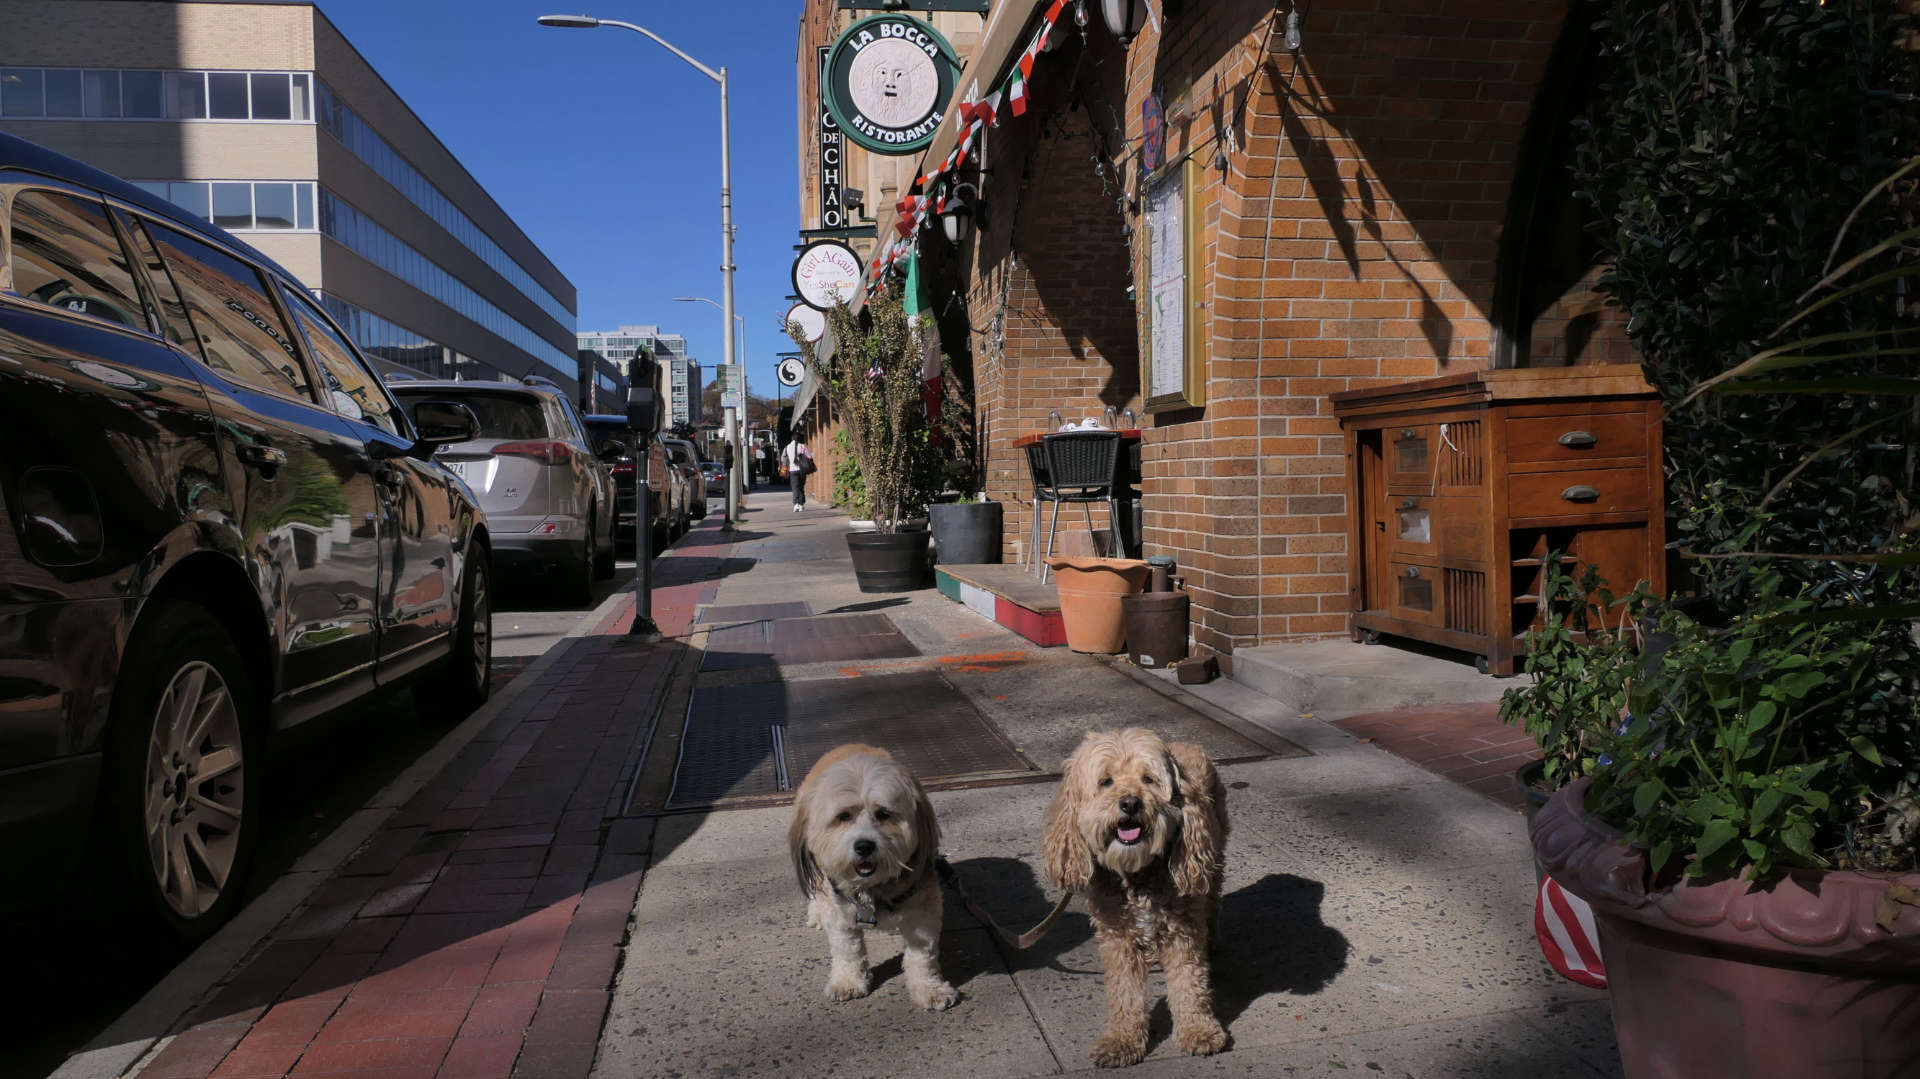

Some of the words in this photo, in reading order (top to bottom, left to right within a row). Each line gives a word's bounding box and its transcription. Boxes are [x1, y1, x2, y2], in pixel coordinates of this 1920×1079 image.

[849, 30, 874, 52] LA
[880, 24, 938, 58] BOCCA
[823, 133, 838, 144] DE
[852, 111, 943, 143] RISTORANTE
[801, 254, 820, 279] Girl
